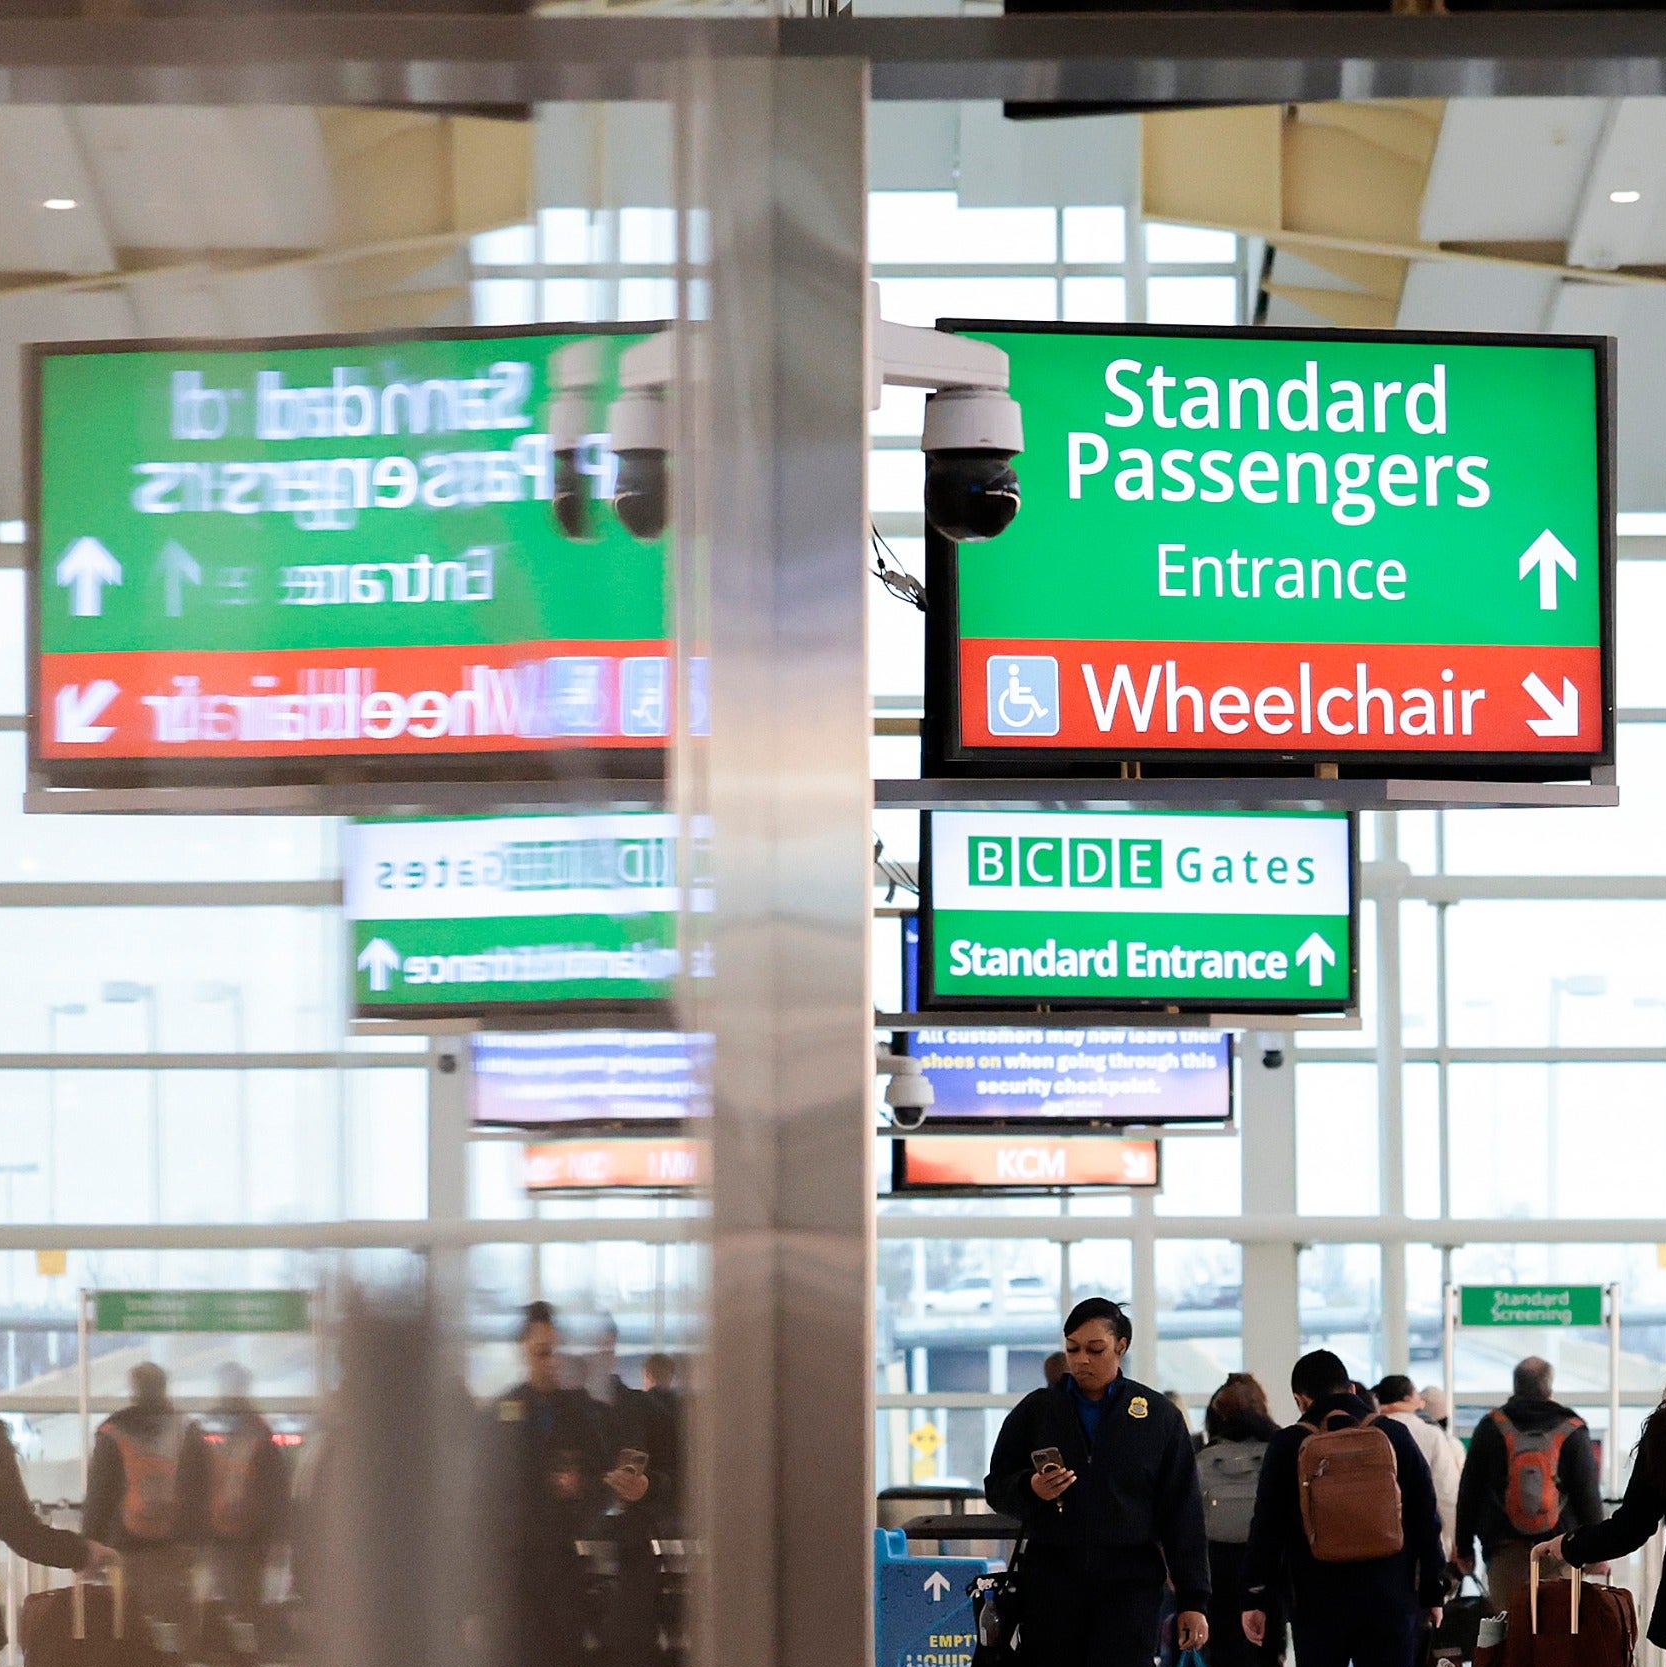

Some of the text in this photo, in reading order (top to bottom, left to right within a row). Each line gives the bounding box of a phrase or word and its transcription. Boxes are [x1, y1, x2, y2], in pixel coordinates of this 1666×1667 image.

[1104, 359, 1447, 435] Standard
[1068, 431, 1491, 526] Passengers
[1157, 543, 1407, 601] Entrance
[1081, 660, 1486, 736] Wheelchair
[1176, 847, 1315, 884] Gates
[949, 938, 1288, 980] Standard Entrance
[917, 1030, 945, 1044] All
[946, 1030, 1044, 1044] customers
[1045, 1030, 1085, 1047] may
[1086, 1031, 1126, 1044] now
[921, 1052, 1217, 1073] shoes on when going through this
[976, 1077, 1162, 1098] security checkpoint.
[997, 1148, 1066, 1178] KCM
[1494, 1291, 1570, 1306] Standard
[1491, 1307, 1572, 1324] Screening
